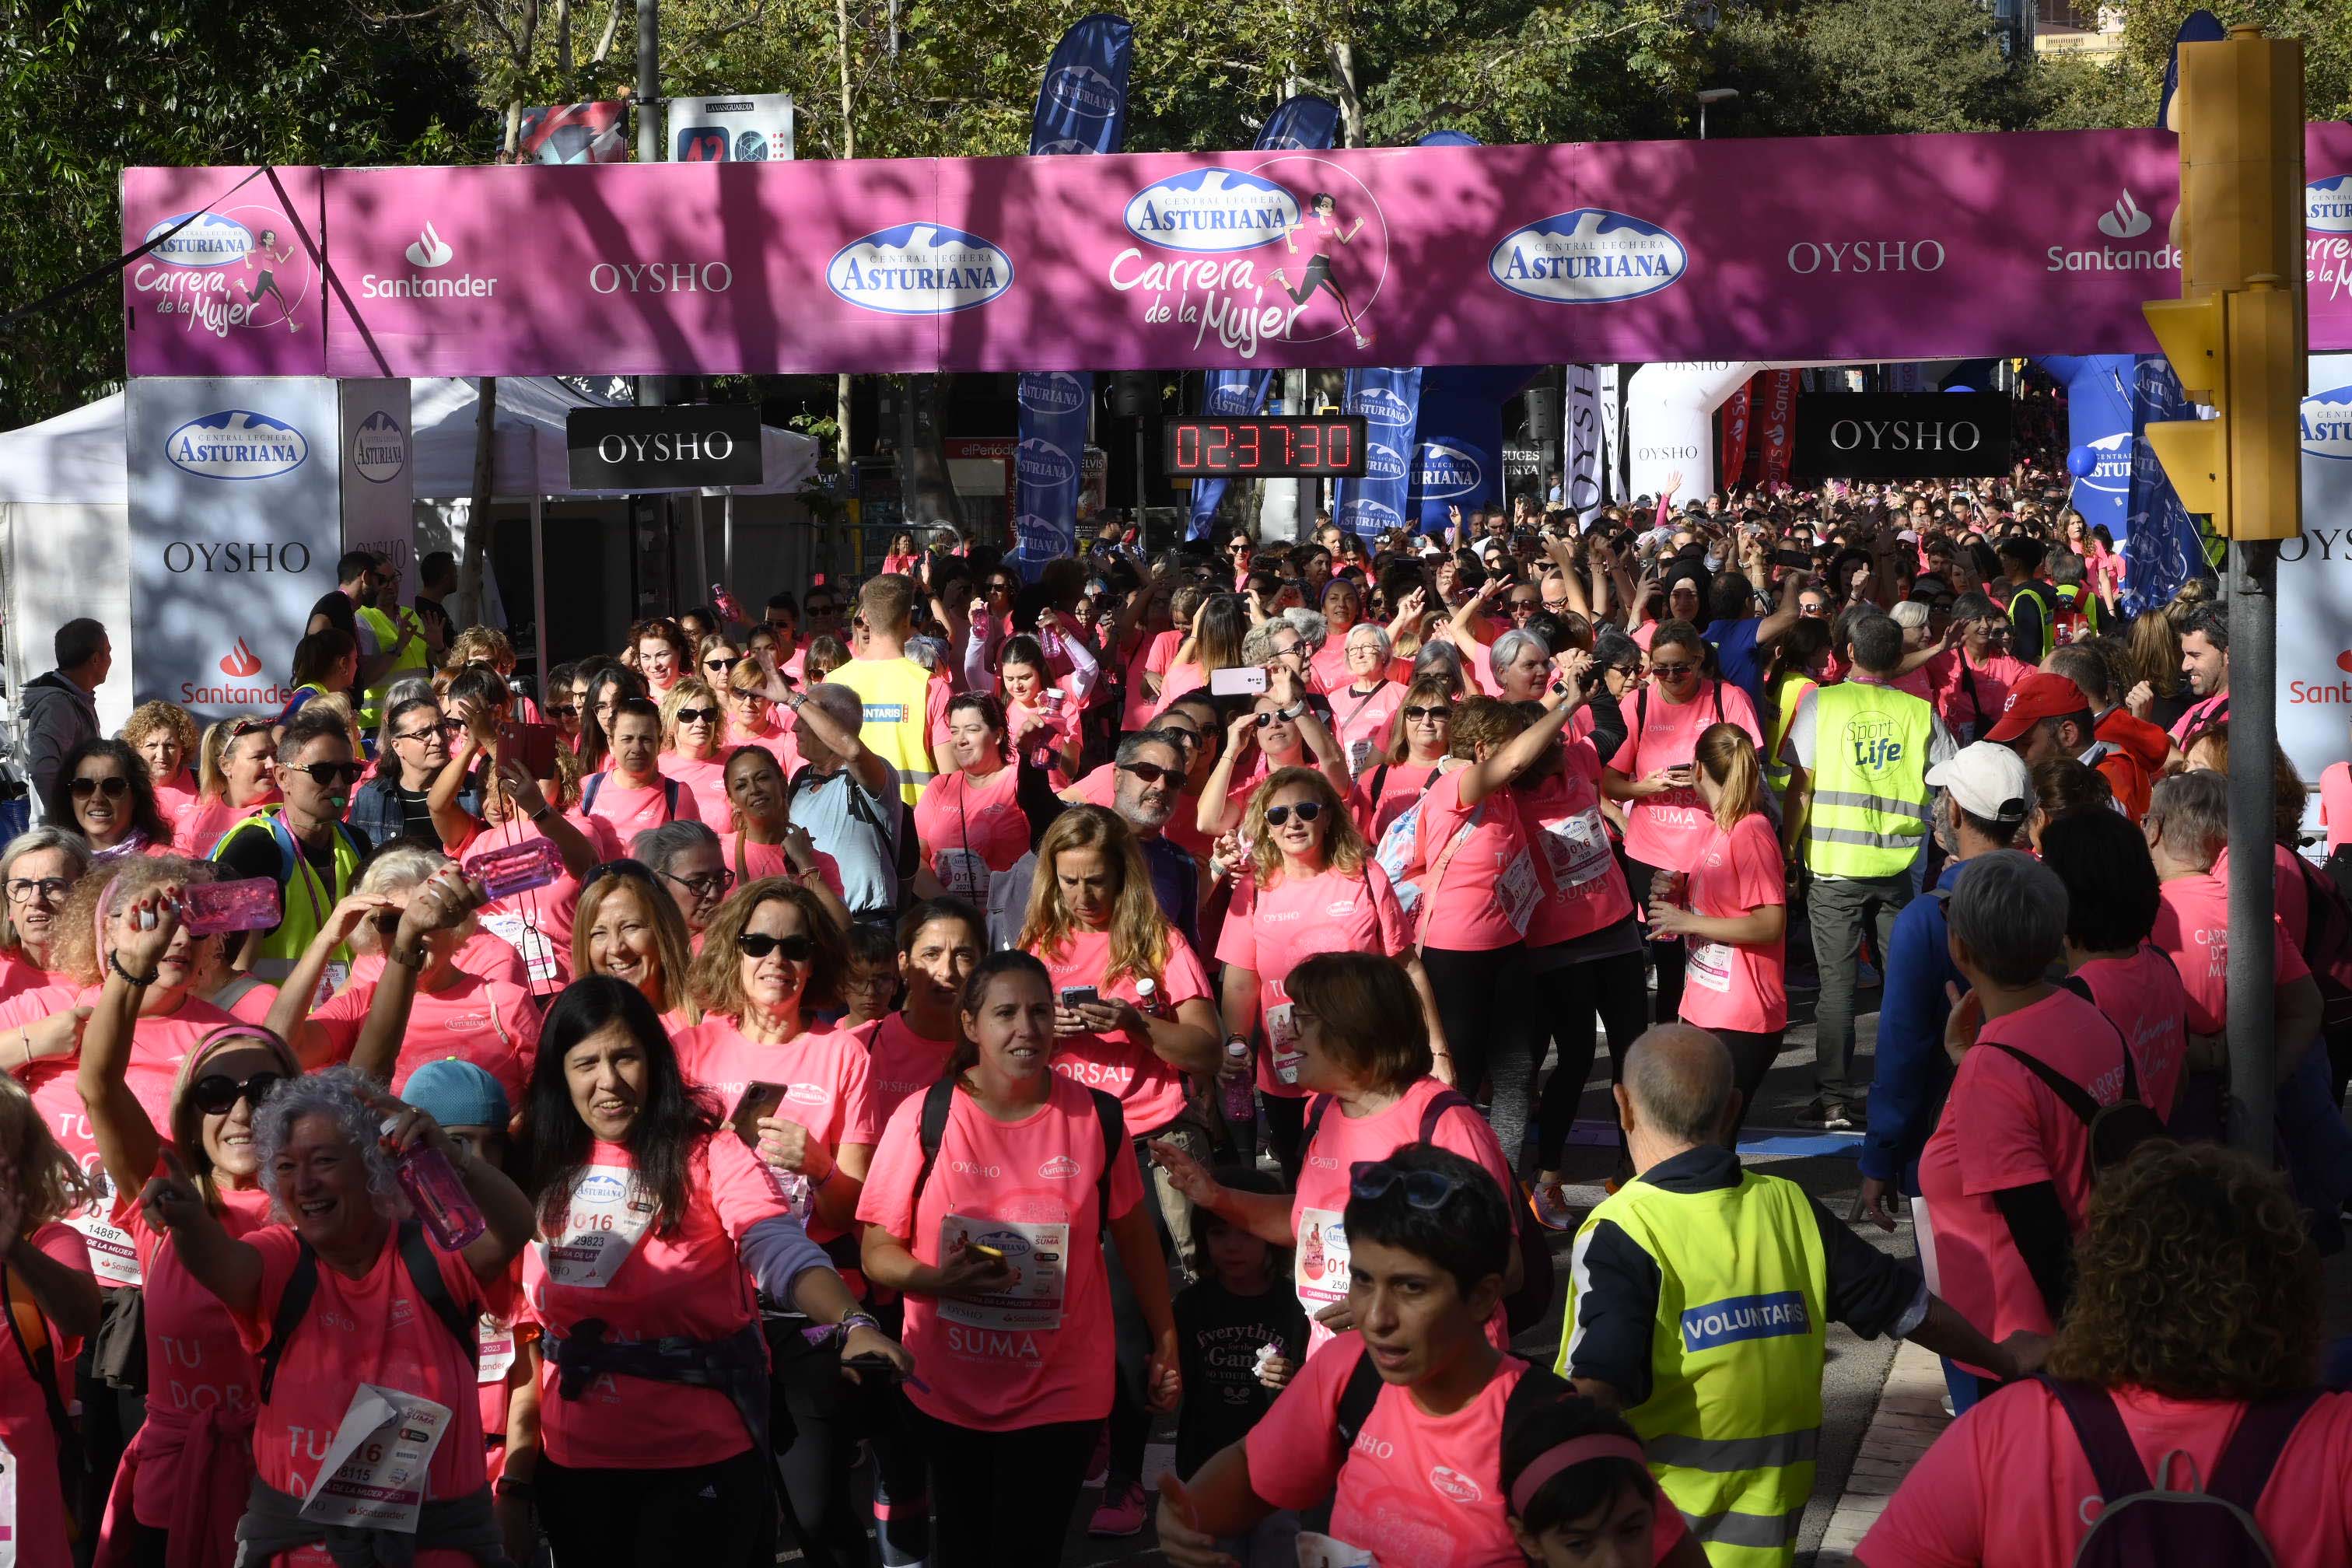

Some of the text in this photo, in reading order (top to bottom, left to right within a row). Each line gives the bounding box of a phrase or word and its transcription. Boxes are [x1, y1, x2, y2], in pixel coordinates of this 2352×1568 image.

[714, 103, 754, 112] VANGUARDIA
[1164, 195, 1283, 206] CENTRAL LECHERA
[1136, 200, 1288, 231] ASTURIANA
[870, 253, 994, 264] CENTRAL LECHERA
[1534, 240, 1665, 252] CENTRAL LECHERA
[1787, 240, 1945, 274] OYSHO
[2046, 245, 2182, 272] Santande
[842, 255, 999, 292] ASTURIANA
[1108, 247, 1255, 292] Carrera
[1503, 245, 1672, 280] ASTURIANA
[2319, 262, 2333, 282] la
[134, 263, 226, 292] Carrera
[362, 273, 498, 299] Santander
[590, 262, 733, 294] OYSHO
[157, 289, 261, 338] de la Mujer
[1144, 287, 1309, 359] de la Mujer
[1018, 376, 1078, 407] ASTURIANA
[1352, 398, 1407, 423] ASTURIANA
[198, 433, 244, 442] CENTRAL
[597, 431, 733, 464] OYSHO
[1177, 425, 1350, 468] 02:37:30
[1572, 360, 1601, 514] OYSH
[1830, 420, 1981, 452] OYSHO
[177, 436, 298, 463] ASTURIANA
[357, 437, 403, 466] ASTURIANA
[1639, 446, 1699, 461] OYSHO
[163, 541, 311, 573] OYSHO
[180, 682, 292, 705] Santande
[1846, 719, 1894, 744] Sport
[1855, 738, 1902, 771] Life
[1385, 787, 1415, 797] OYSHO
[1649, 807, 1696, 824] SUMA
[1570, 838, 1591, 854] 016
[1263, 911, 1300, 923] OYSHO
[2194, 929, 2228, 945] CARR
[1047, 963, 1079, 974] YSHO
[951, 1161, 1001, 1178] OYSHO
[576, 1184, 621, 1199] ASTURIANA
[88, 1223, 122, 1241] 14887
[573, 1213, 613, 1232] 016
[86, 1238, 135, 1258] DE LA MUJER
[573, 1235, 605, 1247] 29823
[947, 1305, 983, 1320] OYSHO
[1685, 1304, 1805, 1340] VOLUNTARIS
[483, 1343, 502, 1353] 2023
[947, 1327, 1039, 1358] SUMA
[1196, 1322, 1285, 1349] Everythin
[159, 1335, 201, 1369] TU
[1209, 1346, 1260, 1368] Gam
[171, 1381, 255, 1413] DOR
[404, 1412, 435, 1426] SUMA
[287, 1425, 331, 1461] TU
[357, 1507, 407, 1521] Santander
